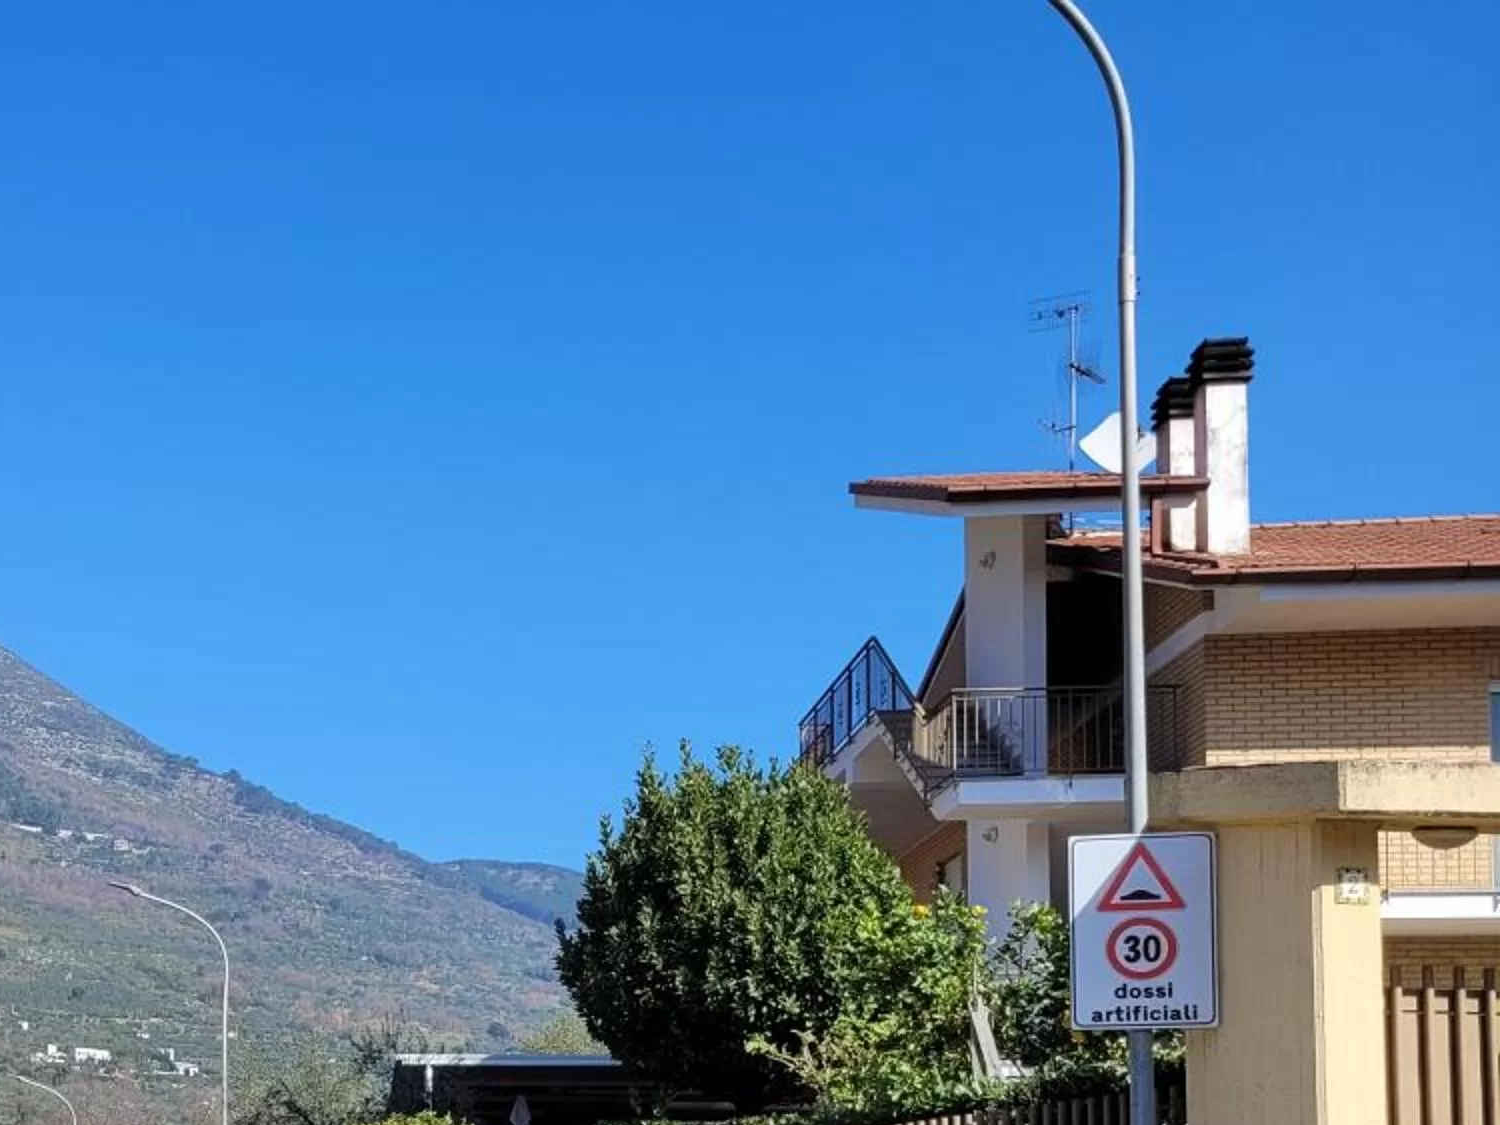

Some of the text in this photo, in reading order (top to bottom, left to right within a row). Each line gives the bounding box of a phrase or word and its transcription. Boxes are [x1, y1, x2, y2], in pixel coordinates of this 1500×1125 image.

[1123, 935, 1162, 963] 30
[1114, 982, 1173, 999] dossi
[1091, 1004, 1199, 1022] artificiali
